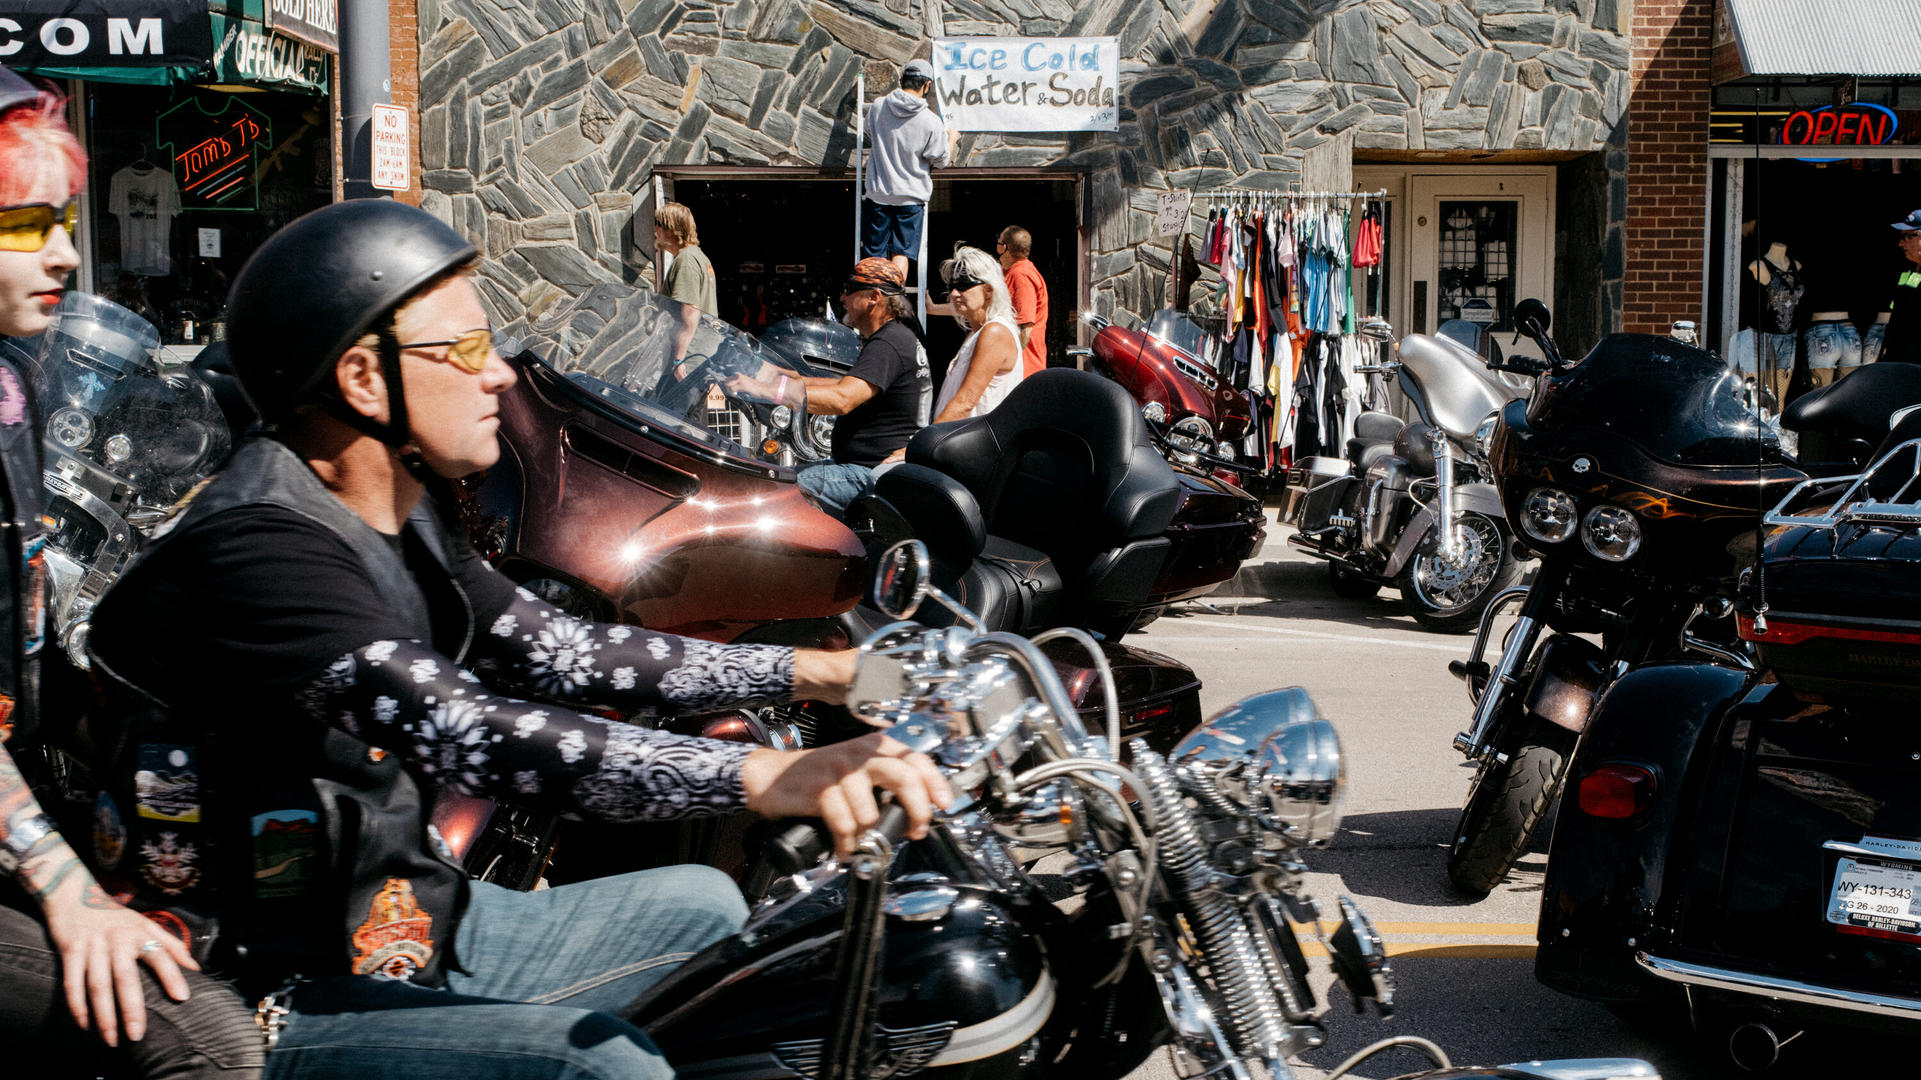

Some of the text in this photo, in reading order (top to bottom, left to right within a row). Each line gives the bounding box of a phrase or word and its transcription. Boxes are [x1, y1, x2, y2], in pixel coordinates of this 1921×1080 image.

[305, 0, 337, 34] HERE
[943, 41, 1100, 72] Ice Cold
[936, 72, 1115, 109] Water & Soda
[384, 114, 397, 129] NO
[1782, 110, 1888, 145] OPEN
[376, 130, 406, 145] PARKING
[1865, 841, 1921, 851] HARLEY-DAVID
[1838, 881, 1912, 899] WY-131-343
[1856, 902, 1868, 911] 26
[1876, 904, 1899, 914] 2020
